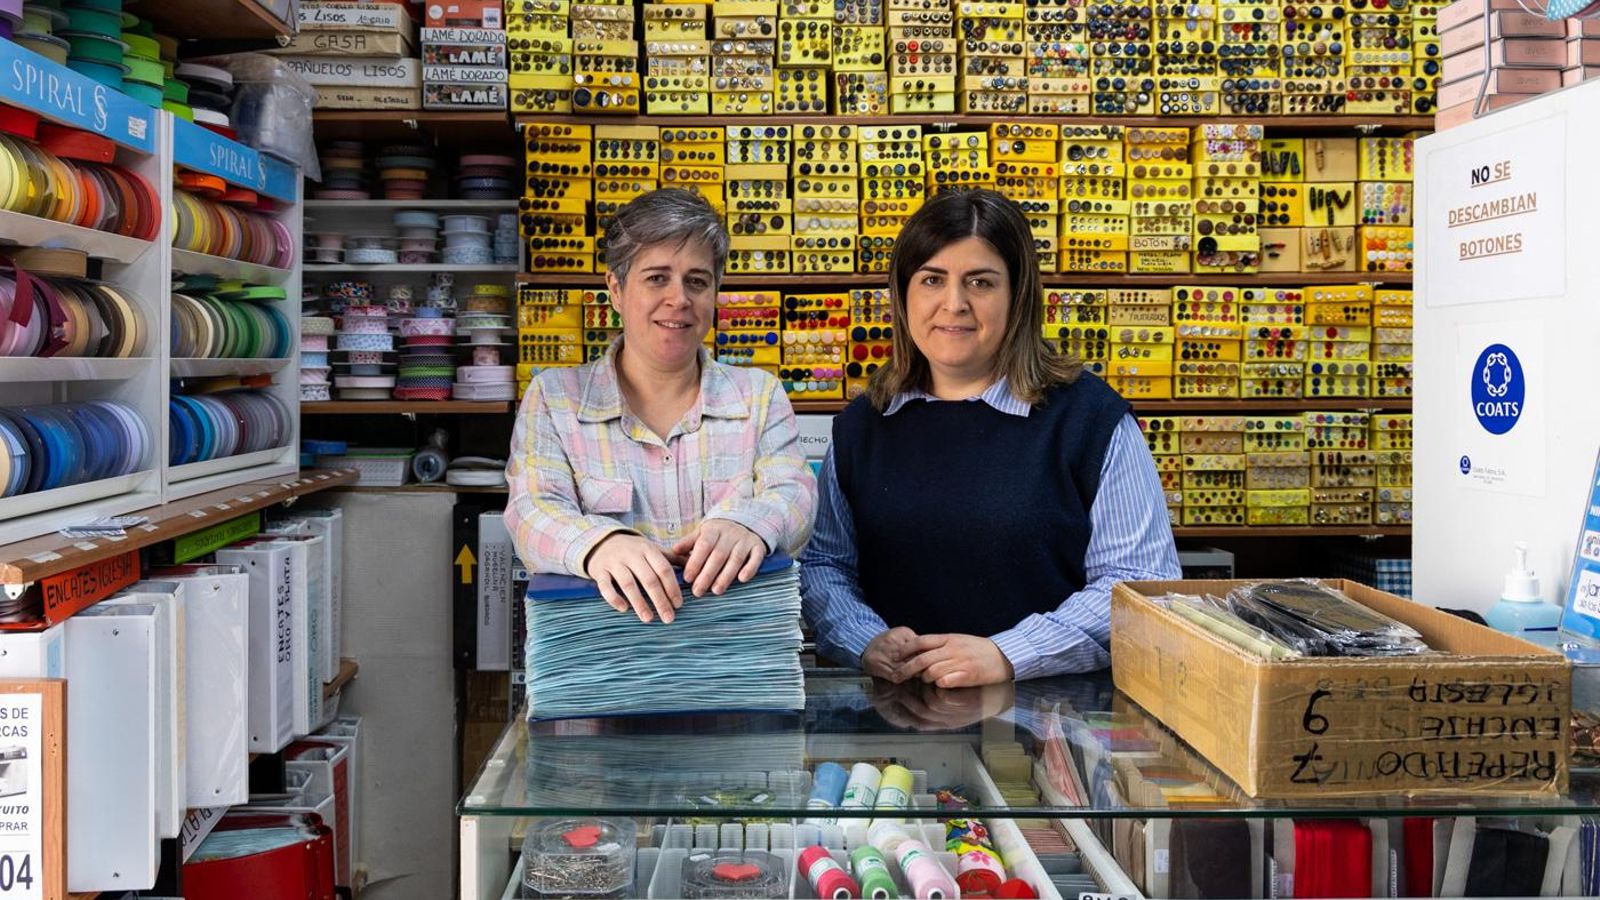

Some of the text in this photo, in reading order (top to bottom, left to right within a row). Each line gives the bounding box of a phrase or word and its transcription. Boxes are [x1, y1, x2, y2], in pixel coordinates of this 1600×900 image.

[313, 34, 367, 49] GASA
[424, 28, 505, 43] LAMÉ DORADO
[449, 47, 496, 64] LAMÉ
[287, 60, 407, 79] PAÑUELOS LISOS
[424, 67, 506, 81] LAMÉ DORADO
[12, 58, 86, 117] SPIRAL
[451, 86, 498, 104] LAMÉ
[209, 142, 254, 180] SPIRAL
[1471, 160, 1511, 185] NO SE
[1448, 192, 1537, 225] DESCAMBIAN
[1459, 233, 1522, 257] BOTONES
[1476, 401, 1519, 417] COATS
[12, 708, 29, 719] DE
[1376, 749, 1557, 781] REPETIDO
[0, 805, 30, 815] UITO
